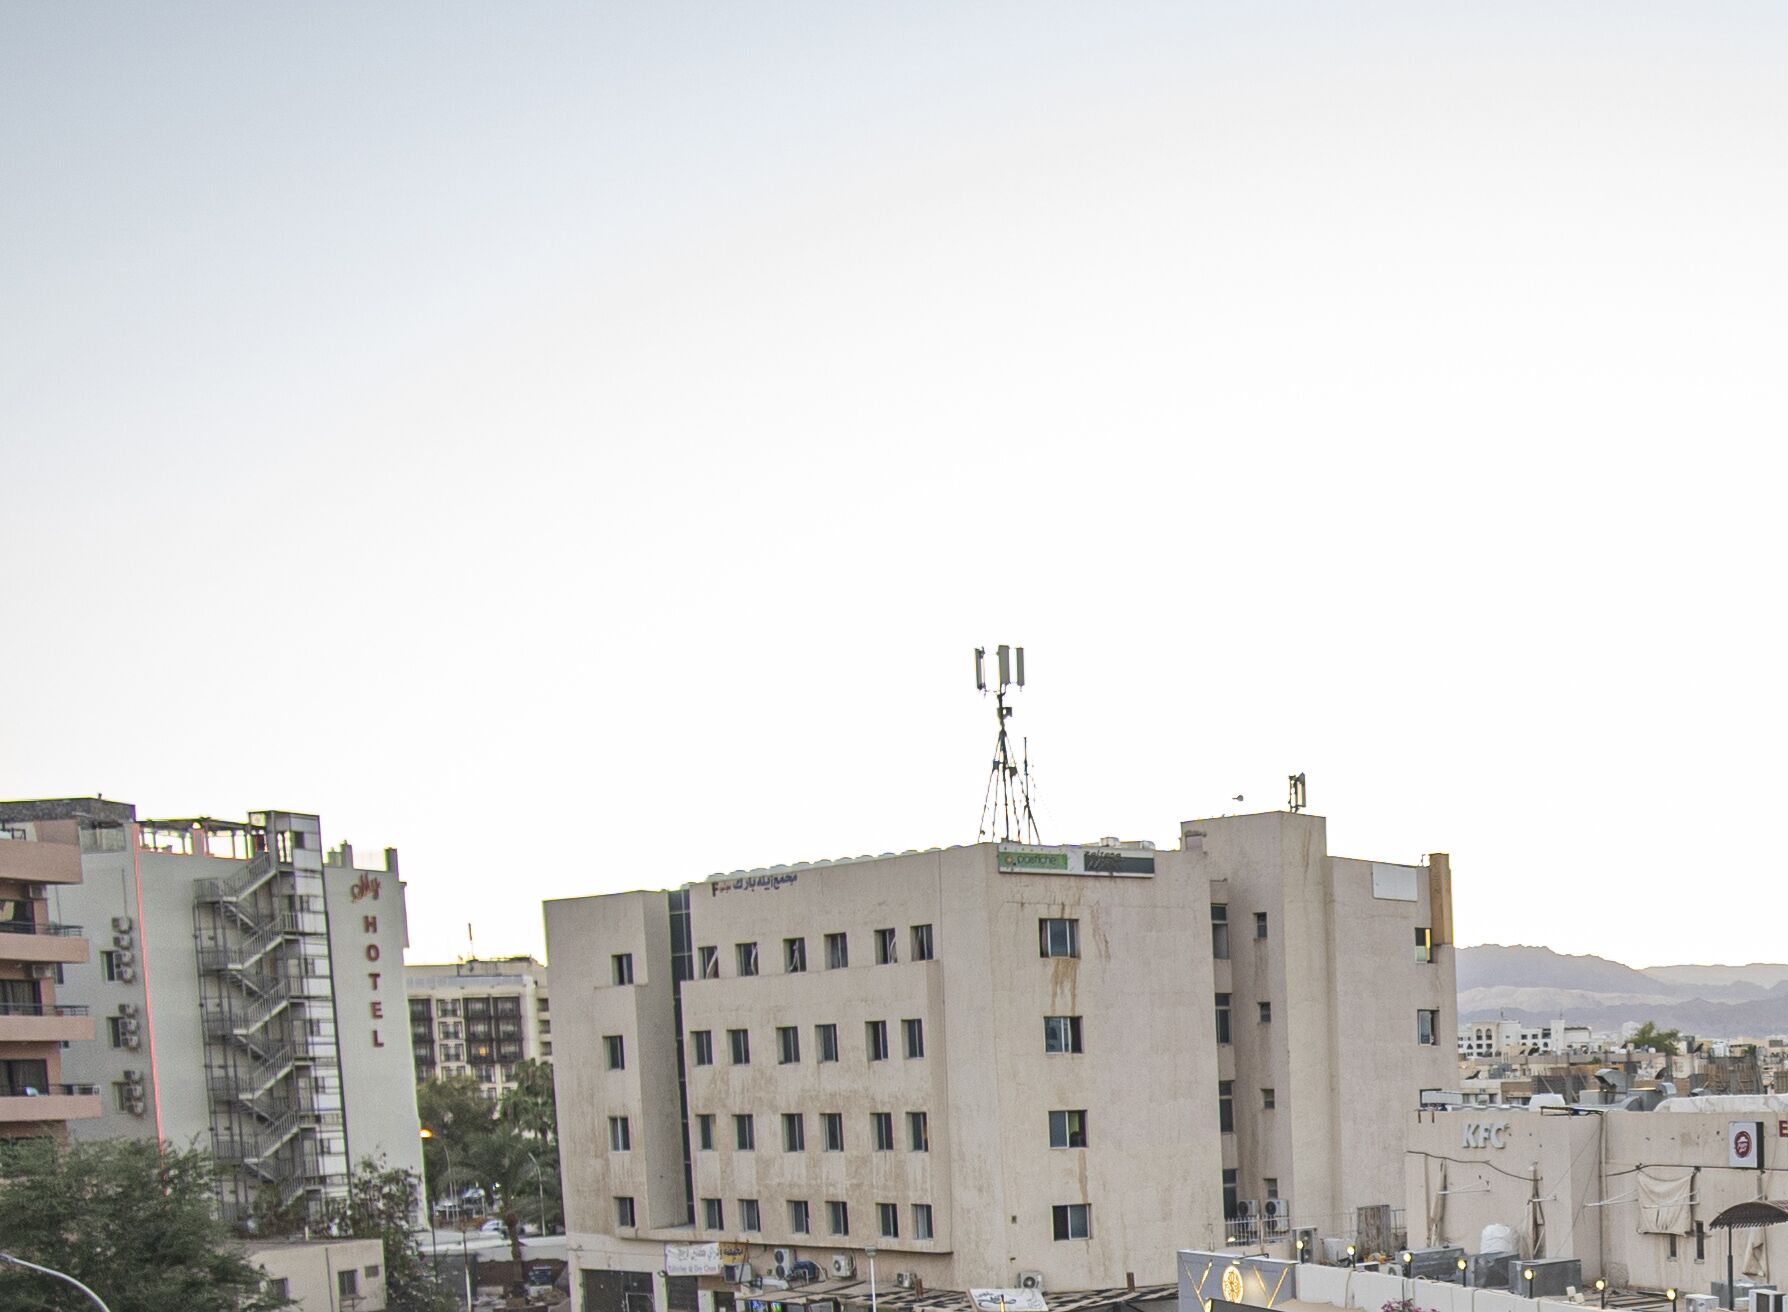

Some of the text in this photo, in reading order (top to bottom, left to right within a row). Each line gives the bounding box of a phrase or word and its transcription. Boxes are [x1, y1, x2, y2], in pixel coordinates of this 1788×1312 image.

[712, 882, 719, 897] F
[362, 915, 385, 1048] HOTEL
[1462, 1121, 1506, 1149] KFC
[1779, 1120, 1788, 1137] E
